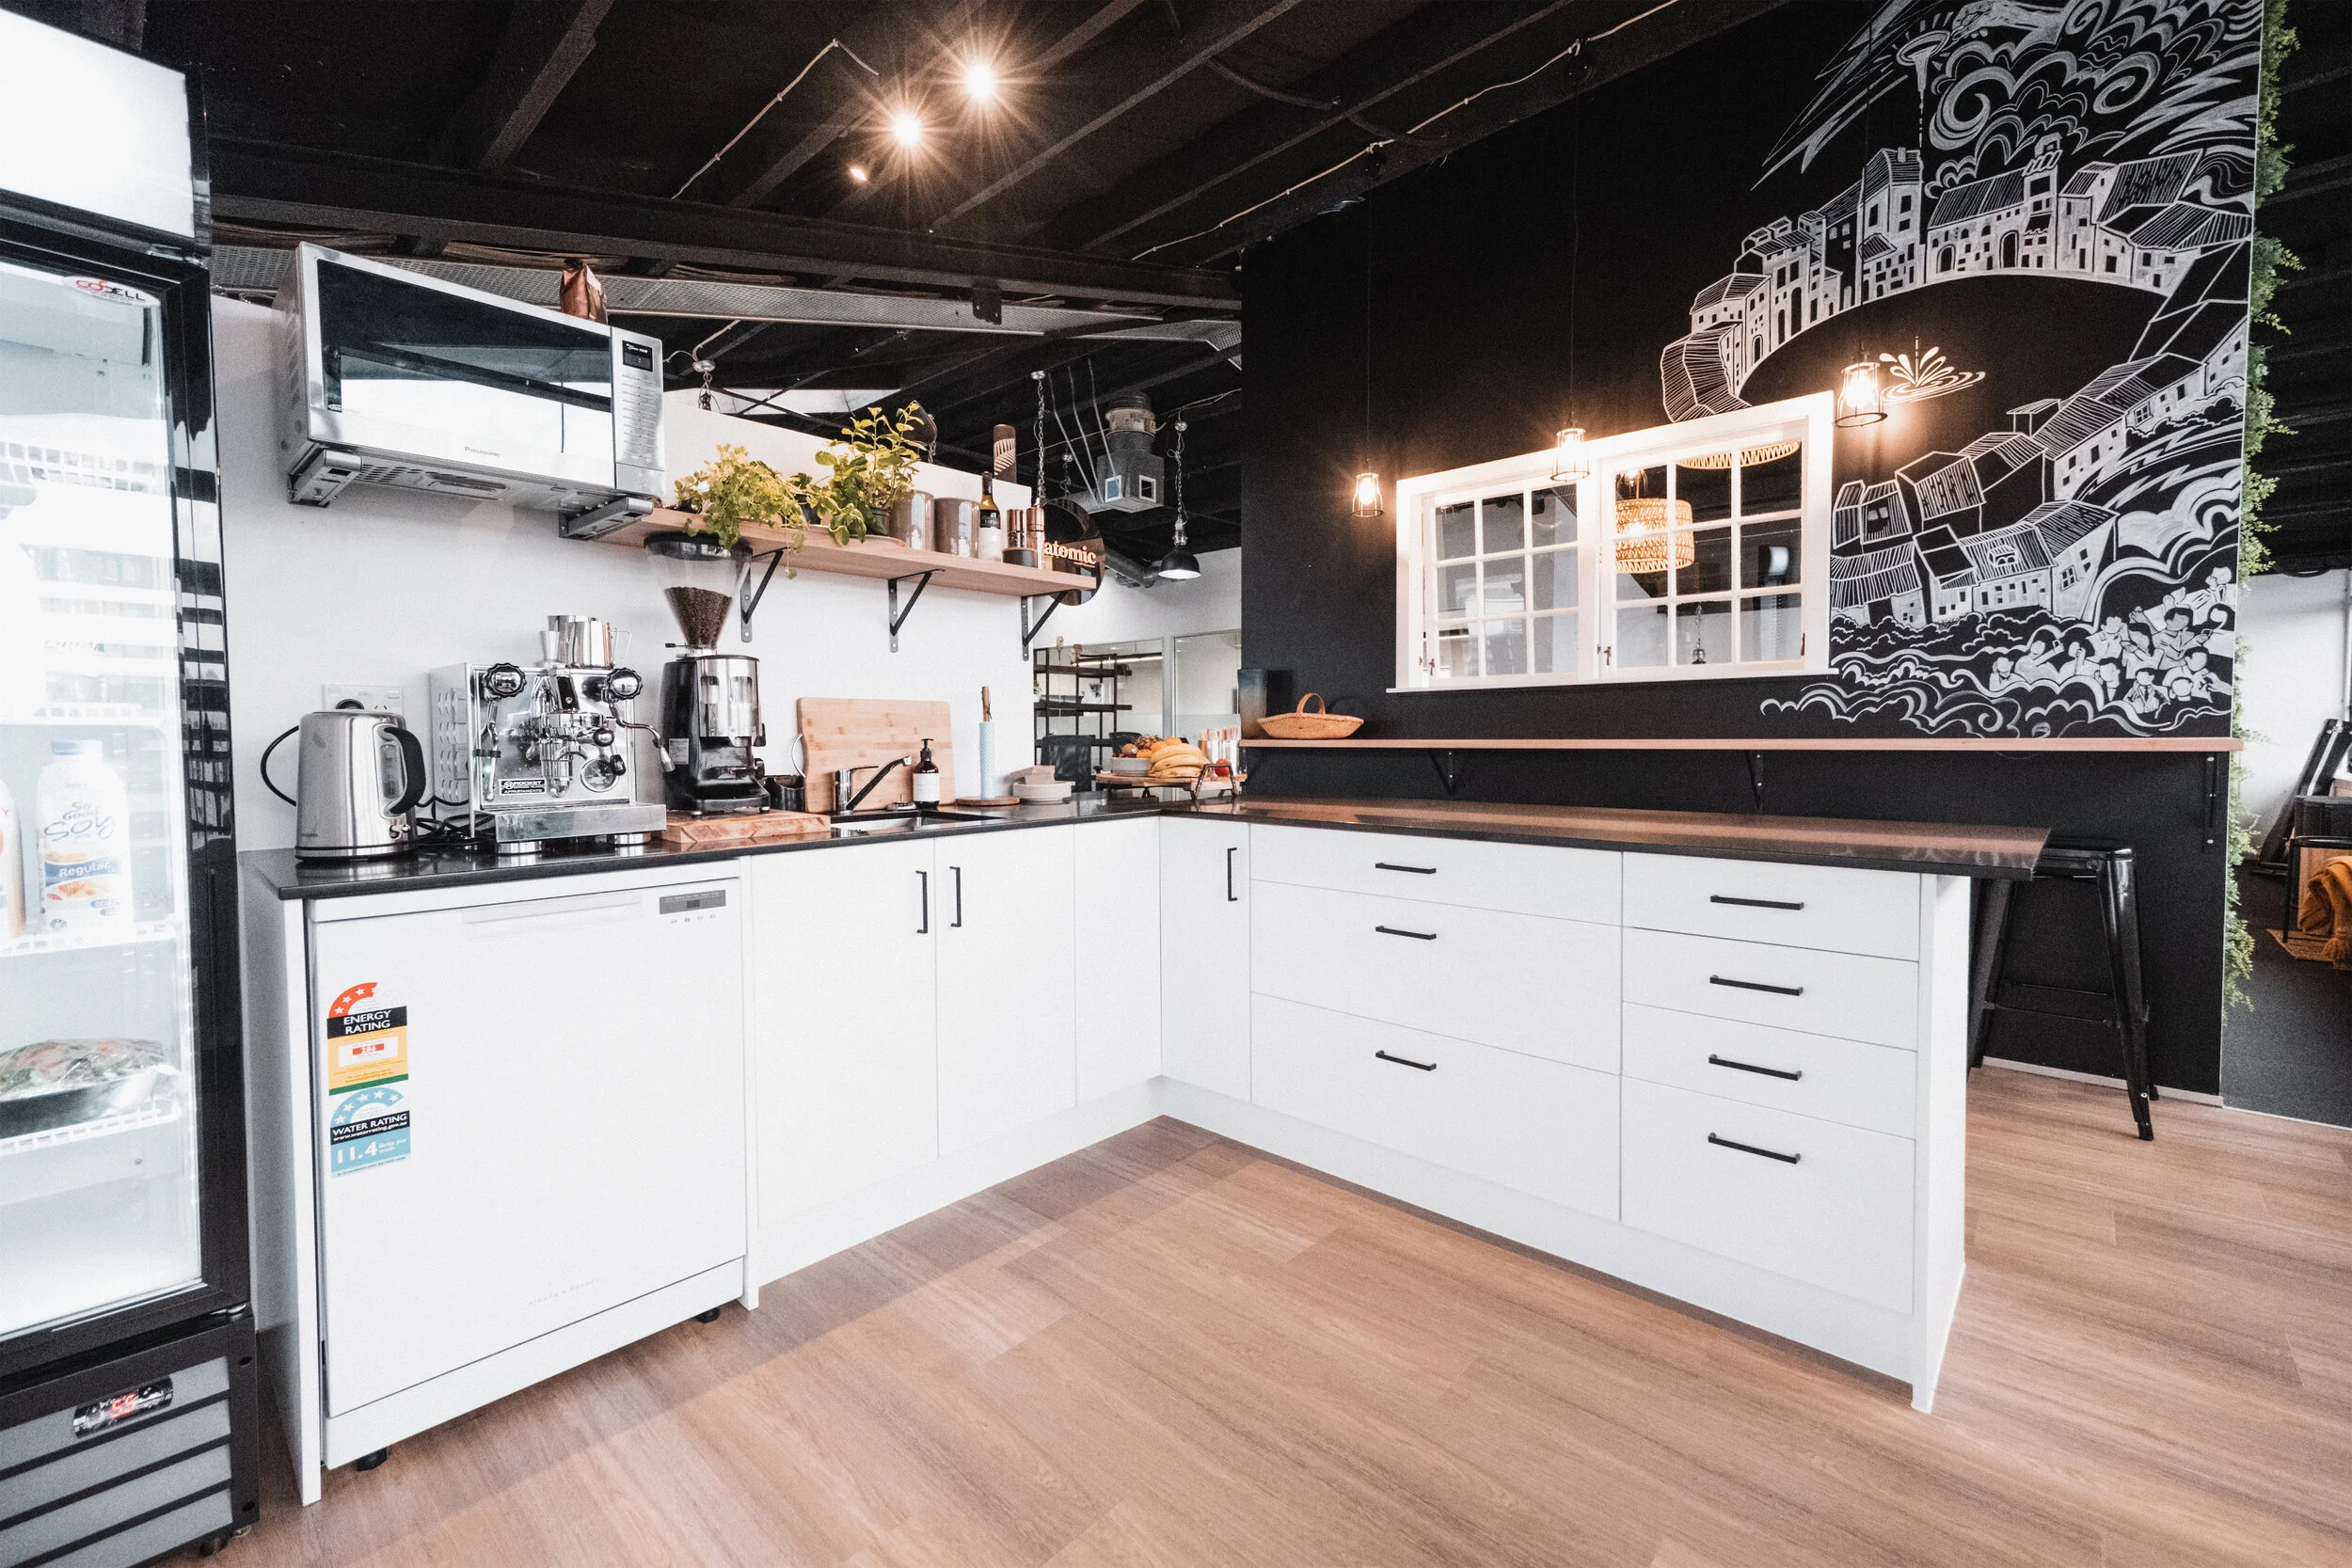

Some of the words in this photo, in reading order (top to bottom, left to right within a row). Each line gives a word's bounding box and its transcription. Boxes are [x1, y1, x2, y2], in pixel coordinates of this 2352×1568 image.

[464, 446, 501, 457] Panasonic
[1043, 540, 1097, 564] atomic
[58, 862, 109, 878] Regular
[343, 1009, 391, 1025] ENERGY
[344, 1020, 391, 1035] RATING
[332, 1122, 368, 1136] WATER
[370, 1113, 407, 1128] RATING
[337, 1140, 377, 1164] 11.4
